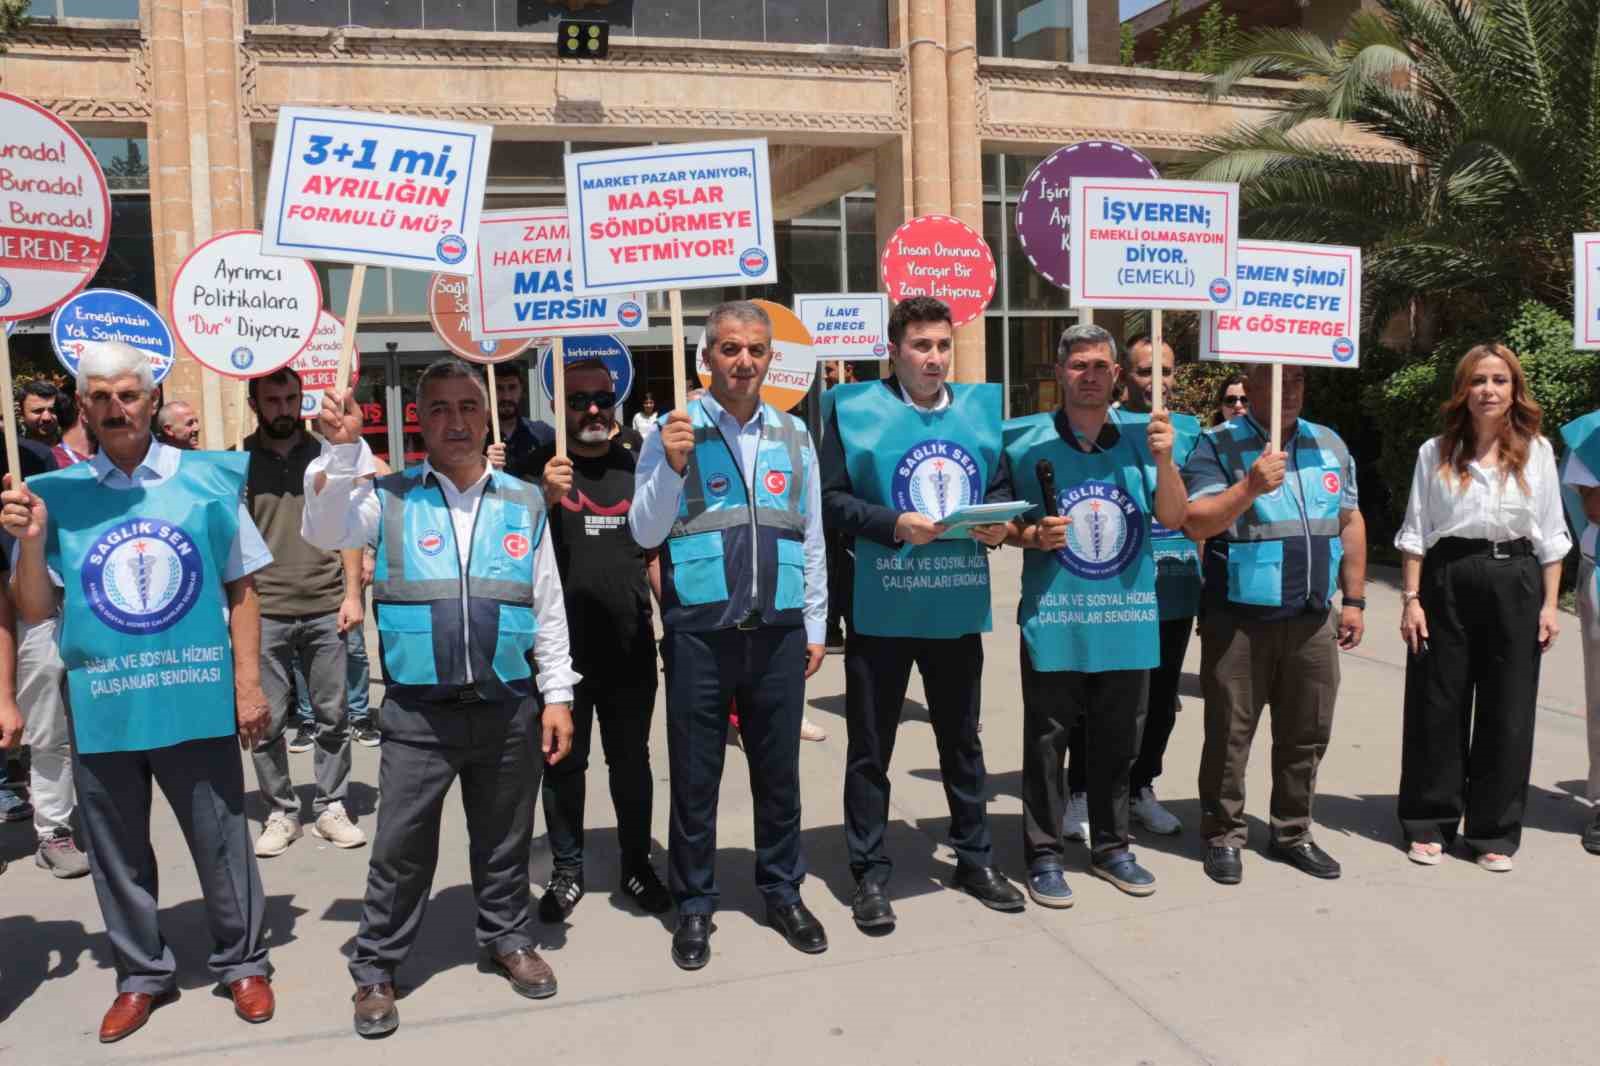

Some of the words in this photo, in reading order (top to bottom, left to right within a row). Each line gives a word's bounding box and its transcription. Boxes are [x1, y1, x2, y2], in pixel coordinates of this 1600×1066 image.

[0, 142, 65, 162] urada!
[303, 135, 378, 170] 3+1
[389, 145, 457, 186] mi,
[583, 175, 641, 190] MARKET
[641, 171, 687, 184] PAZAR
[688, 166, 752, 181] YANIYOR,
[302, 175, 449, 207] AYRILIĞIN
[608, 186, 723, 211] MAAŞLAR
[9, 201, 92, 228] Burada!
[287, 205, 395, 228] FORMULÜ
[400, 214, 453, 234] MÜ?
[1103, 196, 1211, 229] İŞVEREN;
[522, 225, 569, 241] ZAM
[590, 211, 752, 240] SÖNDÜRMEYE
[1089, 228, 1139, 241] EMEKLİ
[1141, 230, 1225, 244] OLMASAYDIN
[0, 236, 90, 263] EREDE?
[493, 247, 562, 266] HAKEM
[609, 238, 735, 264] YETMİYOR!
[934, 242, 980, 257] Onuruna
[1126, 244, 1188, 264] DİYOR.
[214, 258, 282, 284] Ayrımcı
[954, 262, 972, 278] Bir
[1117, 267, 1196, 288] (EMEKLİ)
[1236, 265, 1289, 282] EMEN
[1293, 265, 1345, 287] ŞİMDİ
[193, 285, 298, 310] Politikalara
[899, 281, 926, 297] Zam
[513, 298, 607, 321] VERSİN
[825, 306, 861, 317] İLAVE
[1242, 291, 1341, 311] DERECEYE
[238, 315, 300, 341] Diyoruz
[816, 322, 865, 331] DERECE
[1216, 315, 1242, 331] EK
[1246, 314, 1345, 337] GÖSTERGE
[814, 335, 839, 345] ART
[952, 449, 976, 476] SEN
[1110, 489, 1136, 515] SEN
[158, 526, 192, 556] SEN
[918, 558, 932, 570] VE
[1071, 594, 1084, 606] VE
[1087, 592, 1125, 607] SOSYAL
[1126, 590, 1156, 605] HİZME
[120, 653, 137, 669] VE
[139, 648, 180, 667] SOSYAL
[182, 644, 224, 663] HİZMET
[160, 665, 222, 686] SENDİKASI
